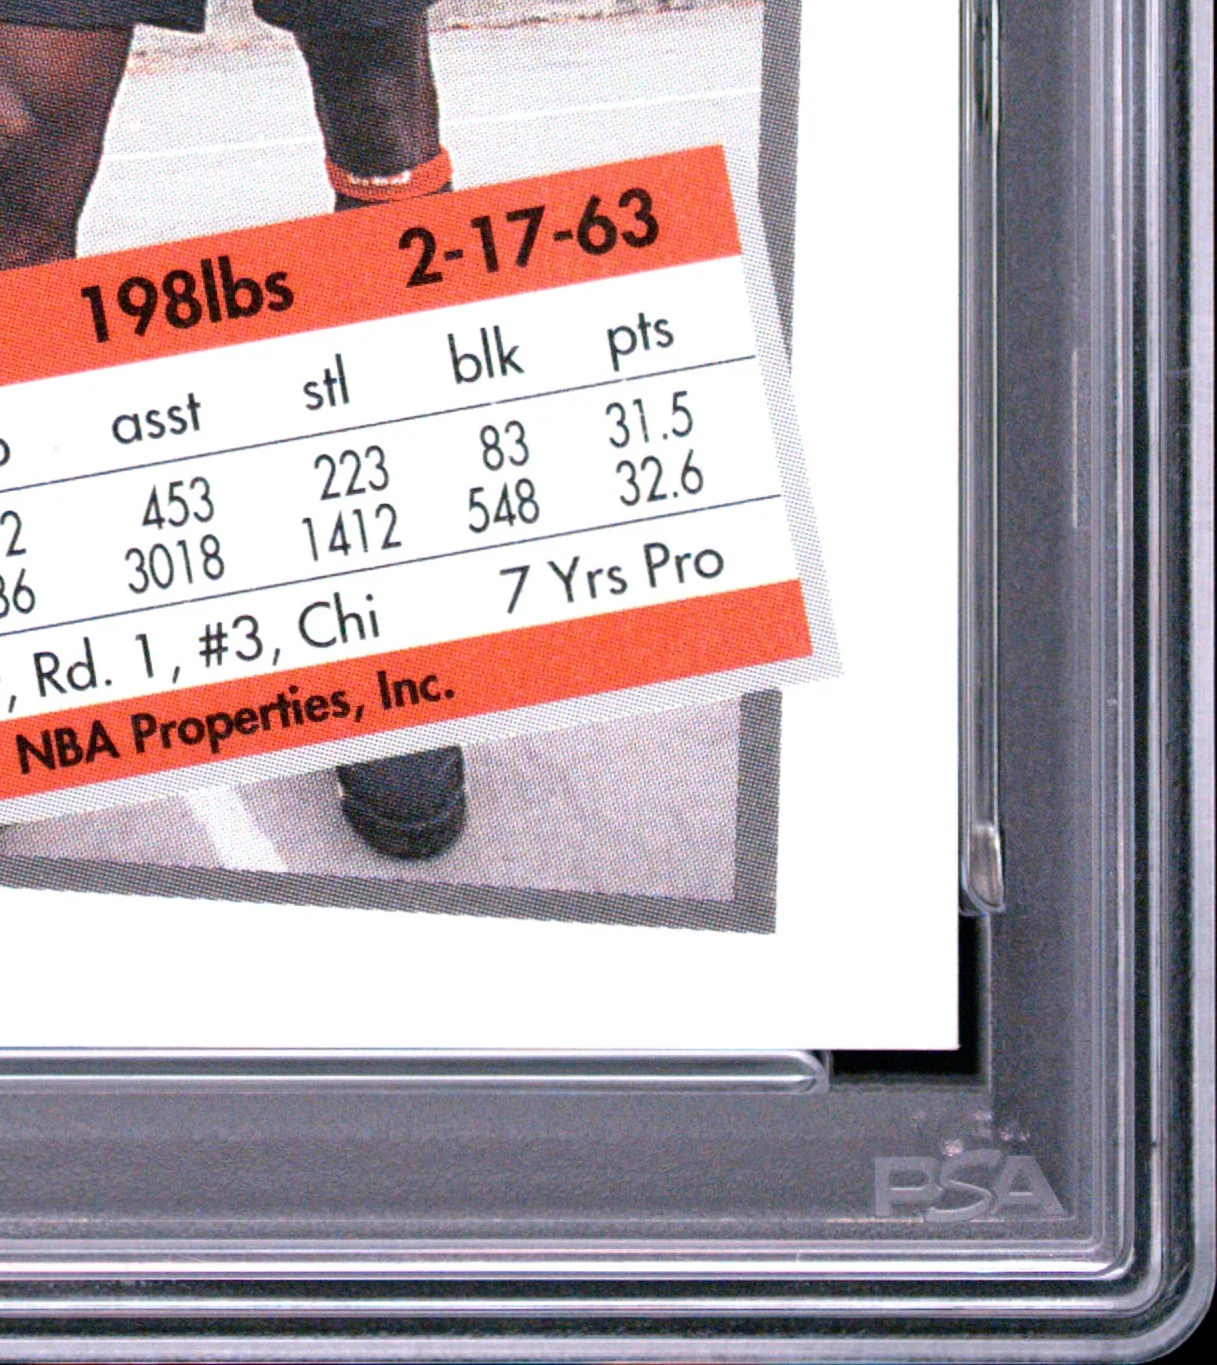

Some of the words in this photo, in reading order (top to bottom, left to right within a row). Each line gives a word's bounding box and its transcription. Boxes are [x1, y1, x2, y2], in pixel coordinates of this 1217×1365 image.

[80, 254, 295, 344] 198lbs
[397, 187, 660, 289] 2-17-63
[111, 392, 201, 445] asst
[303, 352, 350, 411] stl
[446, 324, 525, 385] blk
[606, 311, 675, 372] pts
[124, 533, 225, 595] 3018
[301, 502, 403, 562] 1412
[468, 477, 541, 534] 548
[615, 449, 704, 507] 32.6
[142, 476, 215, 530] 453
[313, 444, 390, 501] 223
[479, 419, 530, 472] 83
[605, 390, 693, 449] 31.5
[32, 636, 113, 698] Rd.
[135, 633, 181, 684] 1,
[198, 614, 281, 668] #3,
[297, 591, 380, 649] Chi
[499, 564, 531, 615] 7
[547, 555, 628, 603] Yrs
[643, 541, 725, 589] Pro
[14, 719, 121, 776] NBA
[130, 684, 365, 755] Properties,
[376, 669, 455, 711] Inc.
[873, 1149, 1065, 1223] PSA
